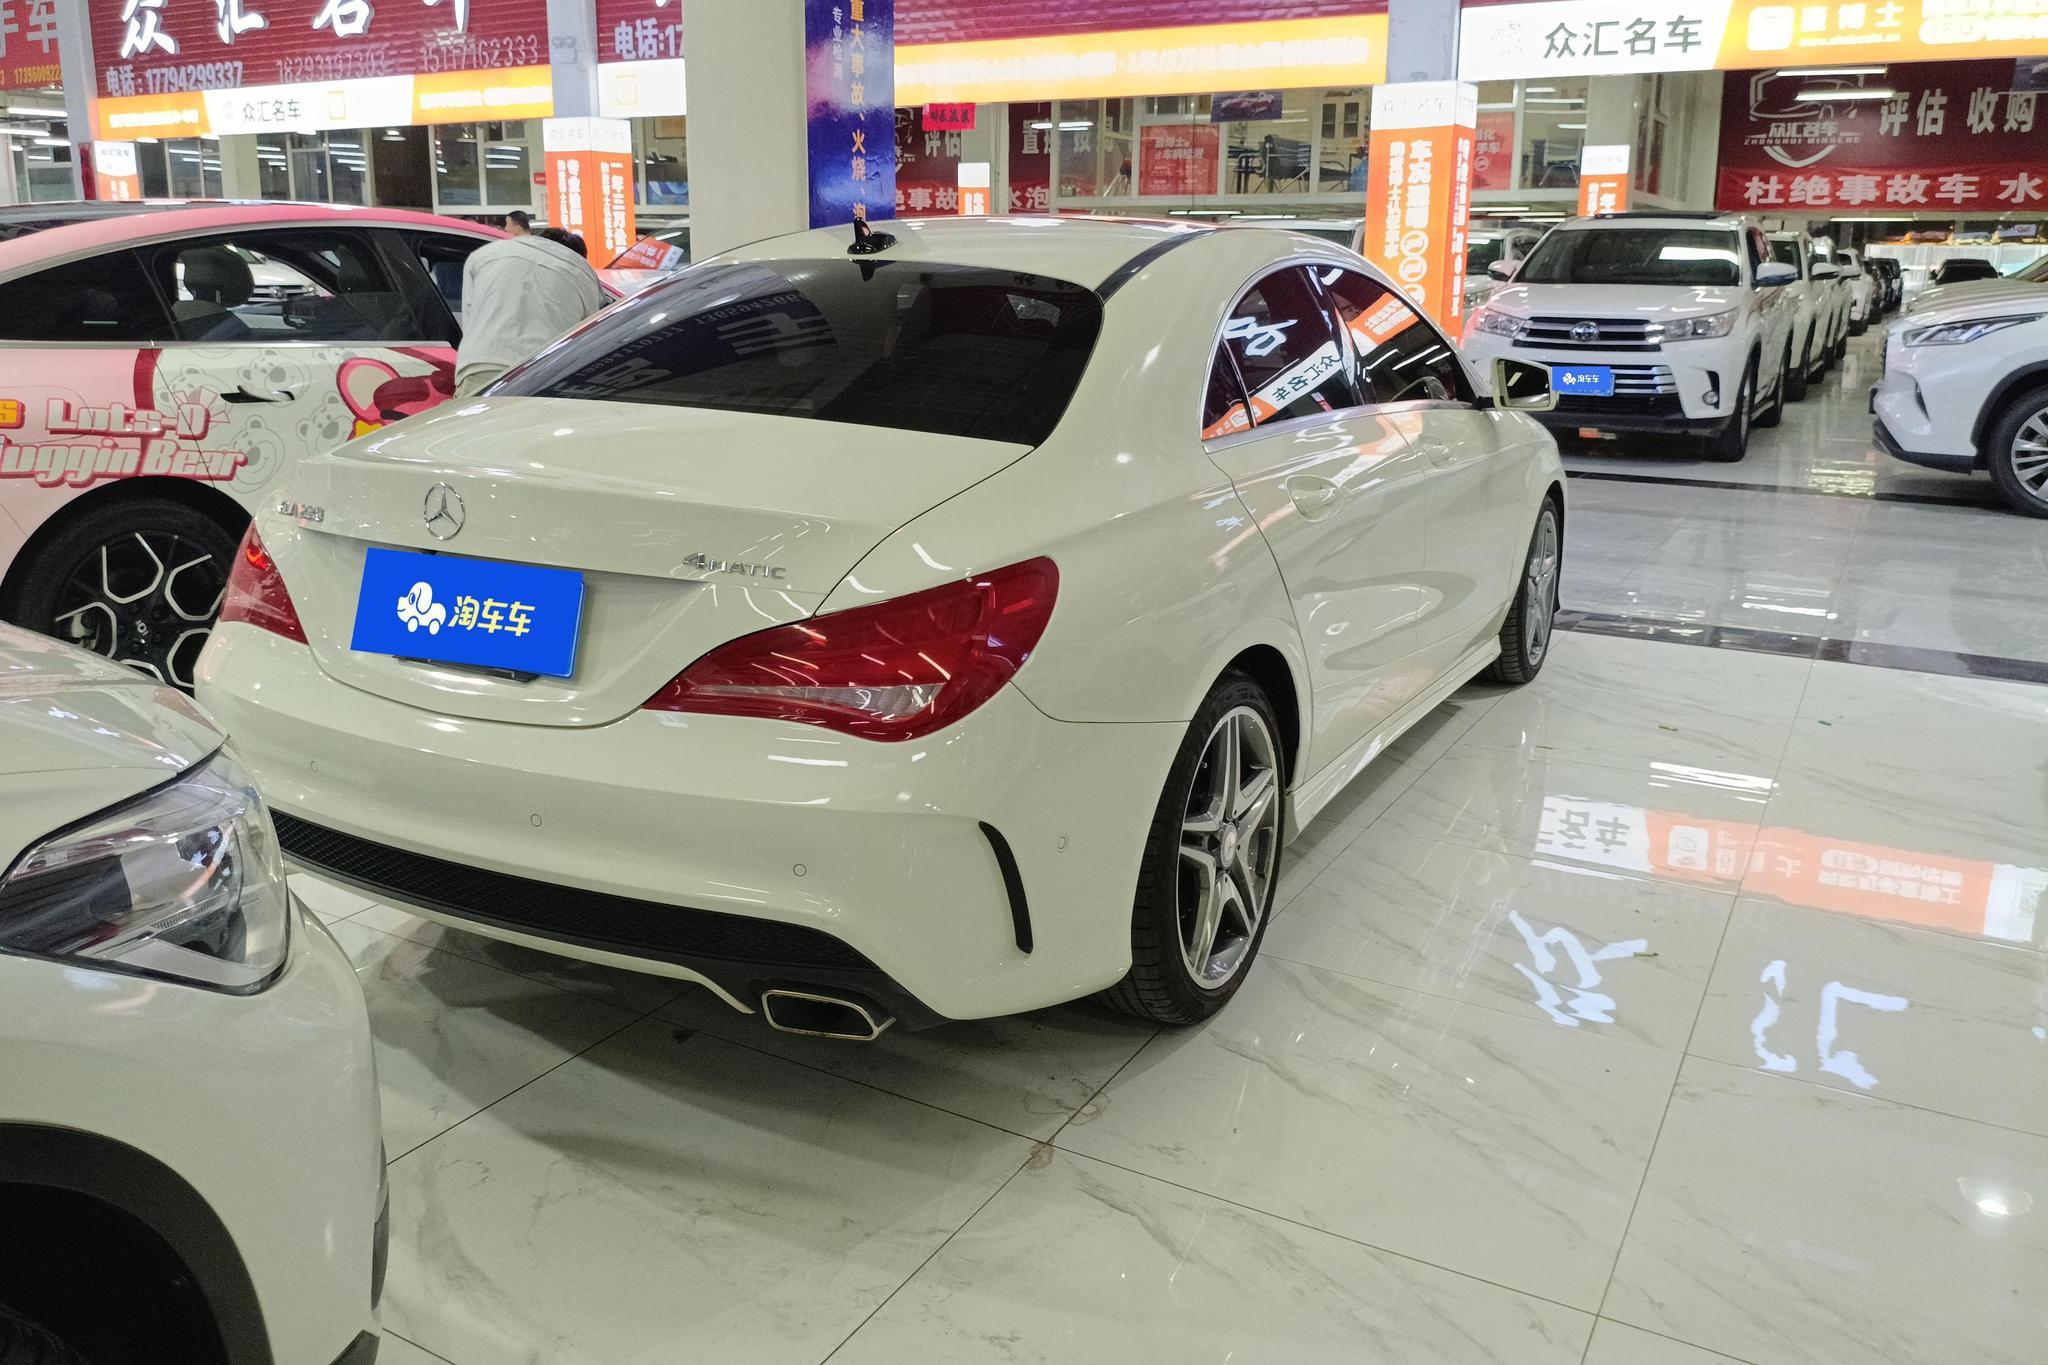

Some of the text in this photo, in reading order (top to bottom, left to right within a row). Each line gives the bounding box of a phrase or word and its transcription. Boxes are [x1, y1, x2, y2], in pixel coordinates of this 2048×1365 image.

[1543, 16, 1703, 58] 众汇名车
[106, 61, 243, 96] 电话:17794299337
[243, 98, 302, 123] 众汇名车
[1879, 86, 2037, 137] 评估 收购
[1744, 172, 1980, 206] 杜绝事故车
[0, 432, 248, 488] uggin Bear
[682, 552, 787, 580] 4MATIC
